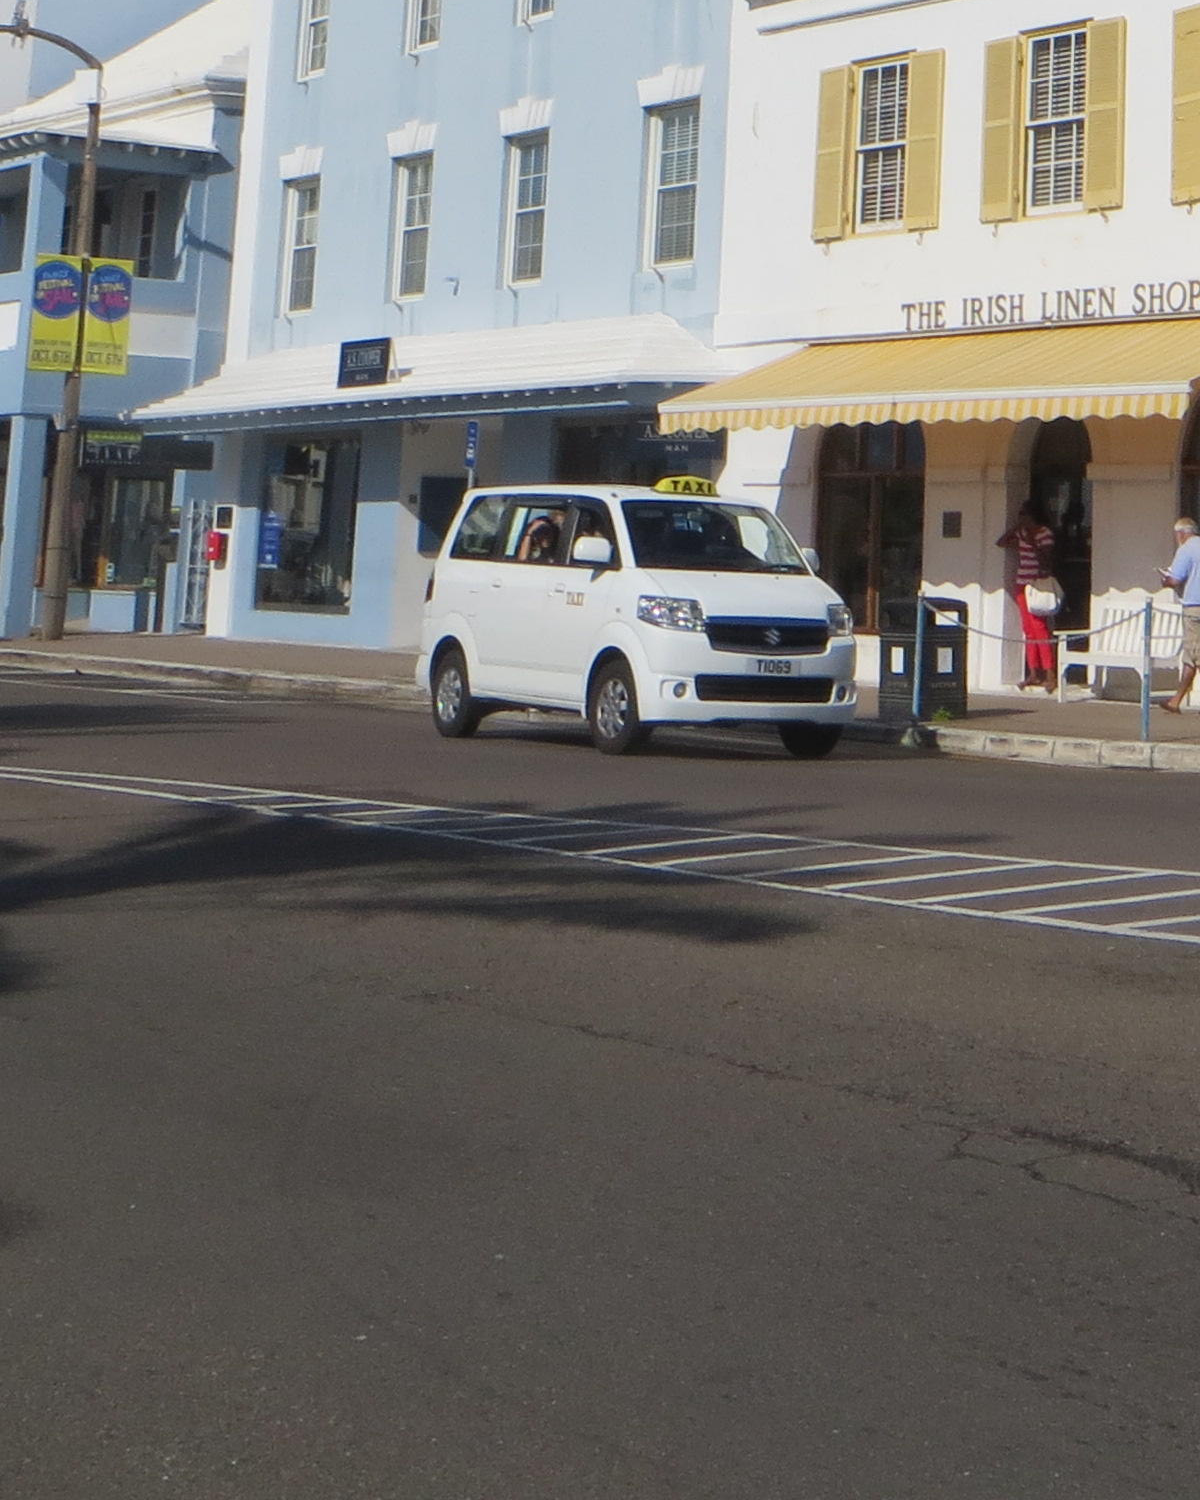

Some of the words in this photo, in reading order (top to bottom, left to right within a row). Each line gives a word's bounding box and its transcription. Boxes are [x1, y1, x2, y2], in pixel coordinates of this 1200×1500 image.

[901, 300, 946, 332] THE
[962, 294, 1024, 325] IRISH
[1041, 287, 1116, 320] LINEN
[665, 444, 688, 452] MAN
[670, 480, 713, 495] TAXI
